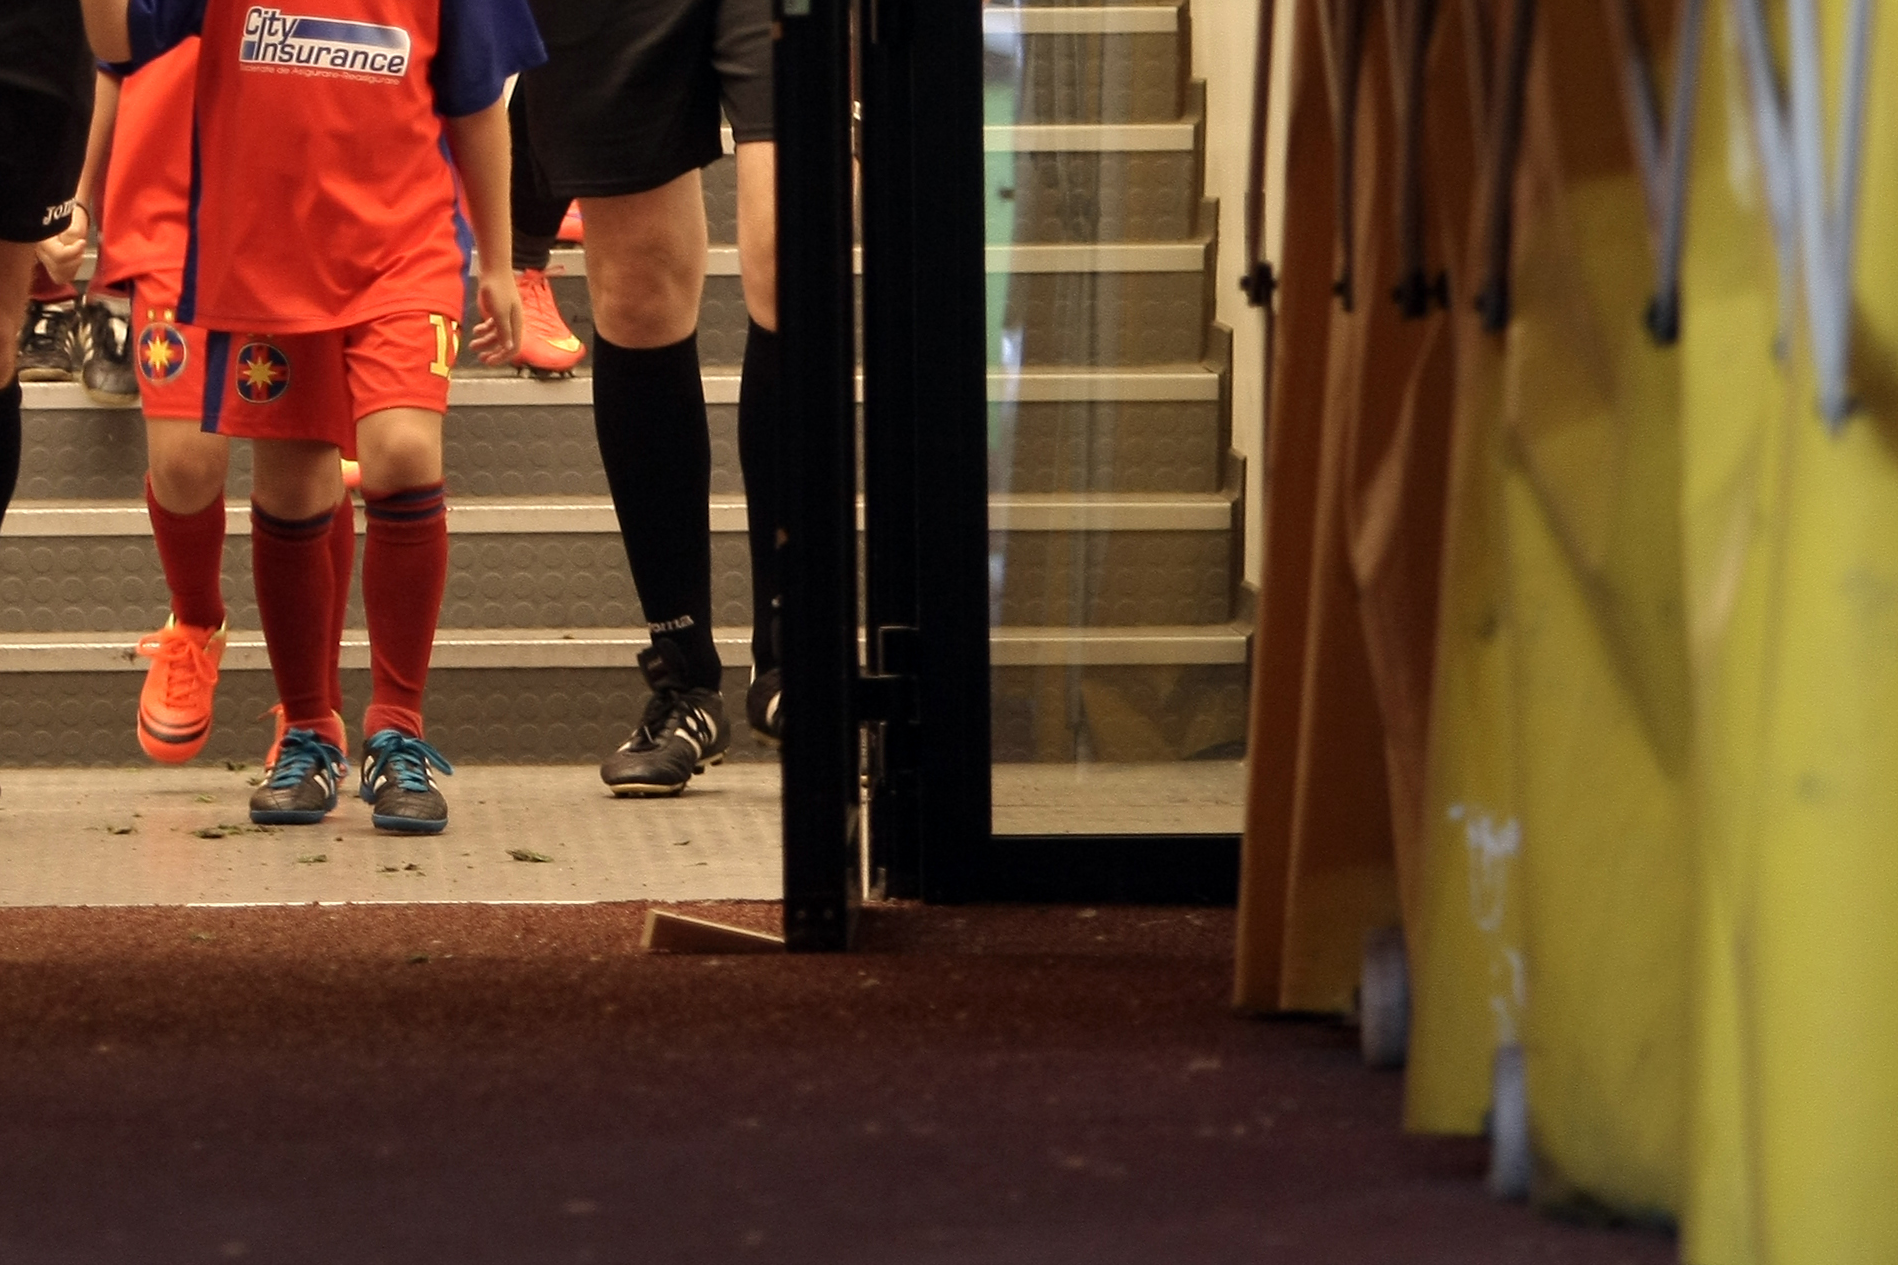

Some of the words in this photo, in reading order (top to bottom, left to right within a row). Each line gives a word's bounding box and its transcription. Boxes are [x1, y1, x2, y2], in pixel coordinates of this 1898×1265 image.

[244, 7, 298, 45] City
[253, 38, 406, 74] Insurance
[428, 313, 460, 378] 1
[647, 615, 694, 633] oma
